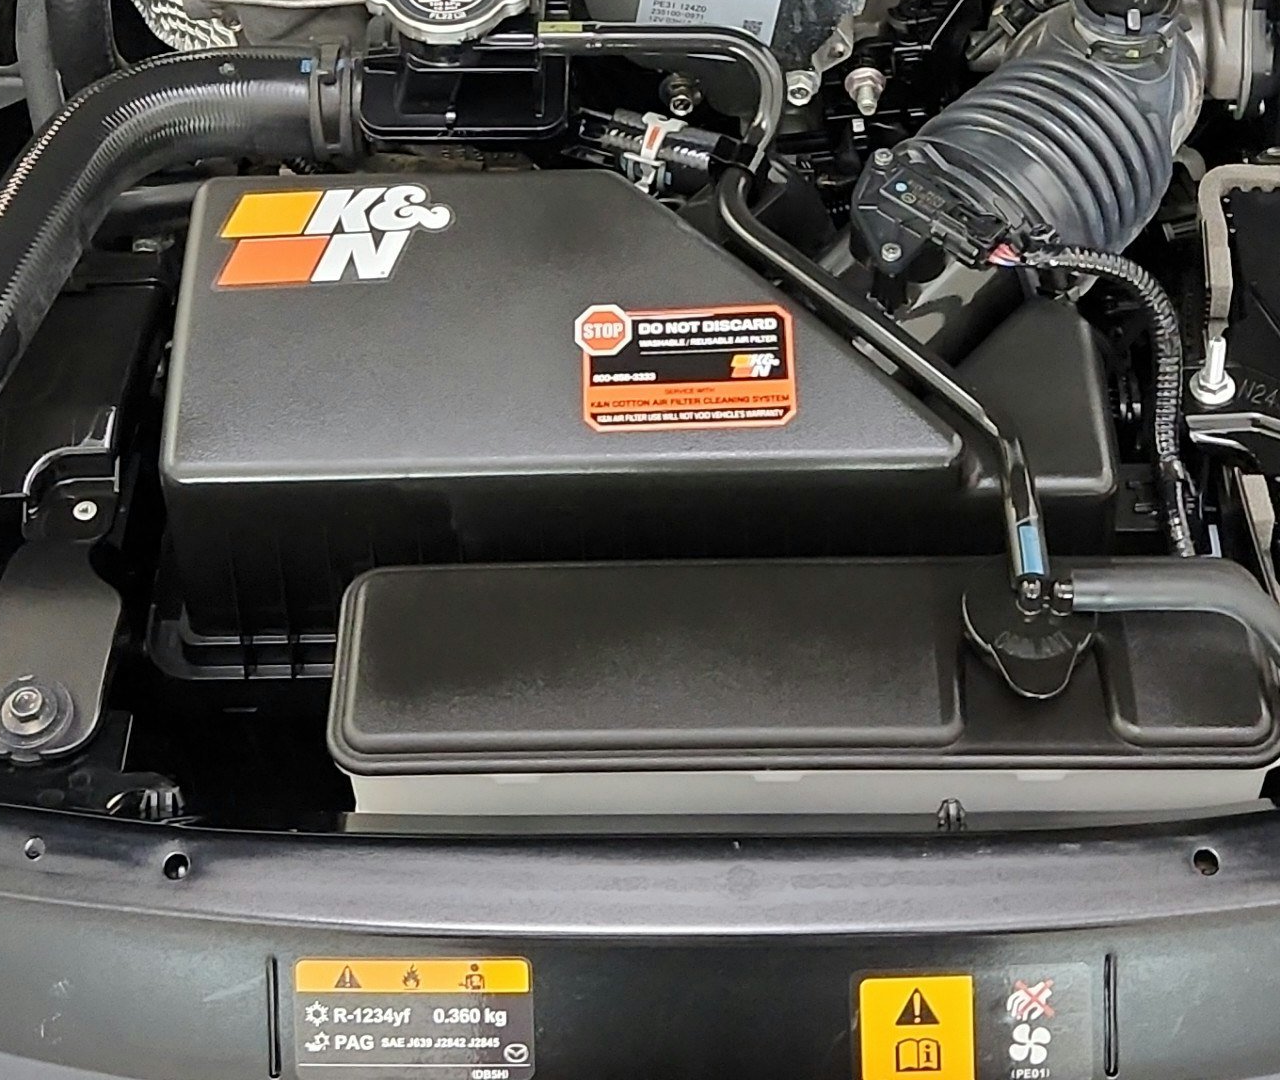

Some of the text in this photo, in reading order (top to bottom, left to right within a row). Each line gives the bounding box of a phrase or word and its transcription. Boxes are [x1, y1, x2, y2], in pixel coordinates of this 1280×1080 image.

[583, 322, 623, 339] STOP
[638, 317, 778, 335] DO NOT DISCARD
[638, 339, 685, 348] WASHABLE
[689, 336, 734, 346] REUSABLE
[734, 336, 750, 344] AIR
[749, 334, 778, 343] FILTER
[612, 400, 650, 408] COTTON
[670, 397, 701, 406] FILTER
[703, 395, 750, 404] CLEANING
[752, 394, 790, 402] SYSTEM
[333, 1007, 508, 1026] R-1234yf 0.360 kg
[334, 1034, 500, 1050] PAG SAE J639 J2842 J2845
[1011, 1068, 1050, 1079] (PE01)
